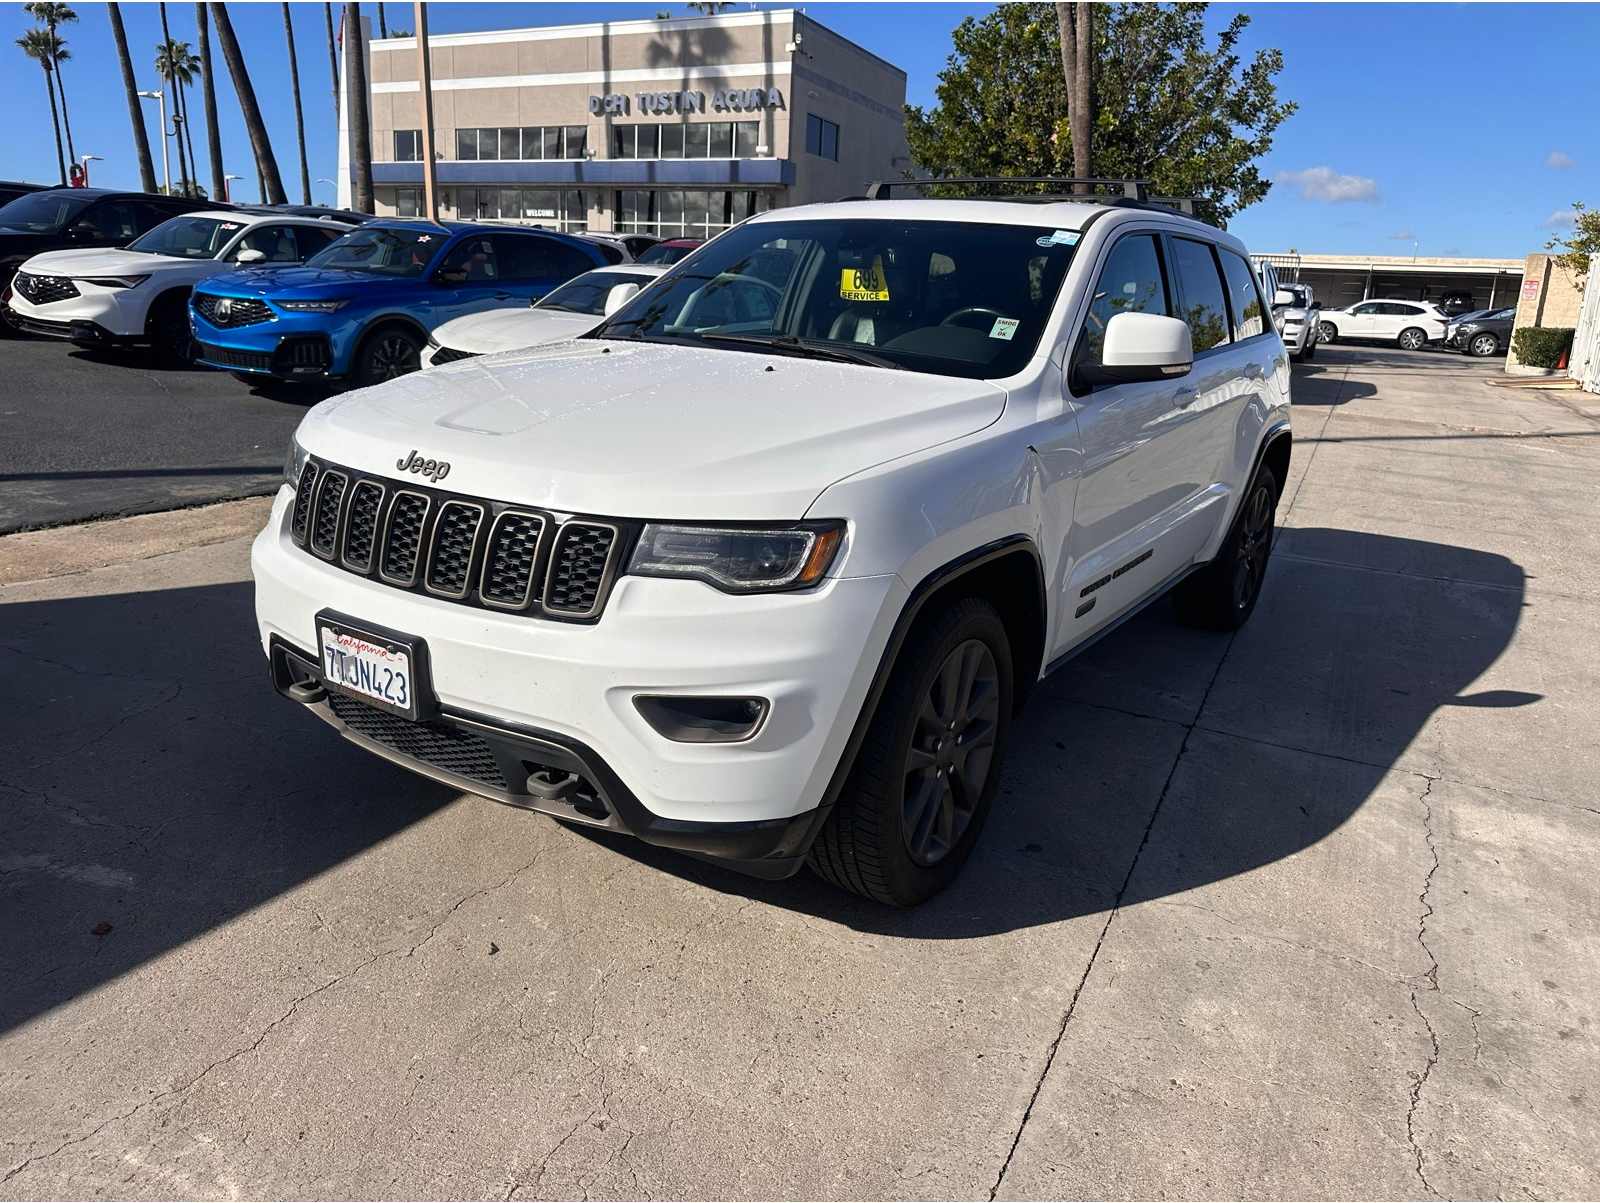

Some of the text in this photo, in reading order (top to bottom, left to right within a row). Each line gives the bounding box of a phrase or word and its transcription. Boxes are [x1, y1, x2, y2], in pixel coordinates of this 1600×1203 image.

[588, 88, 781, 113] DCH TUSTIN ACURA
[841, 291, 880, 300] SERVICE
[396, 449, 451, 484] Jeep
[337, 634, 388, 657] California
[325, 646, 407, 705] 7TJN423
